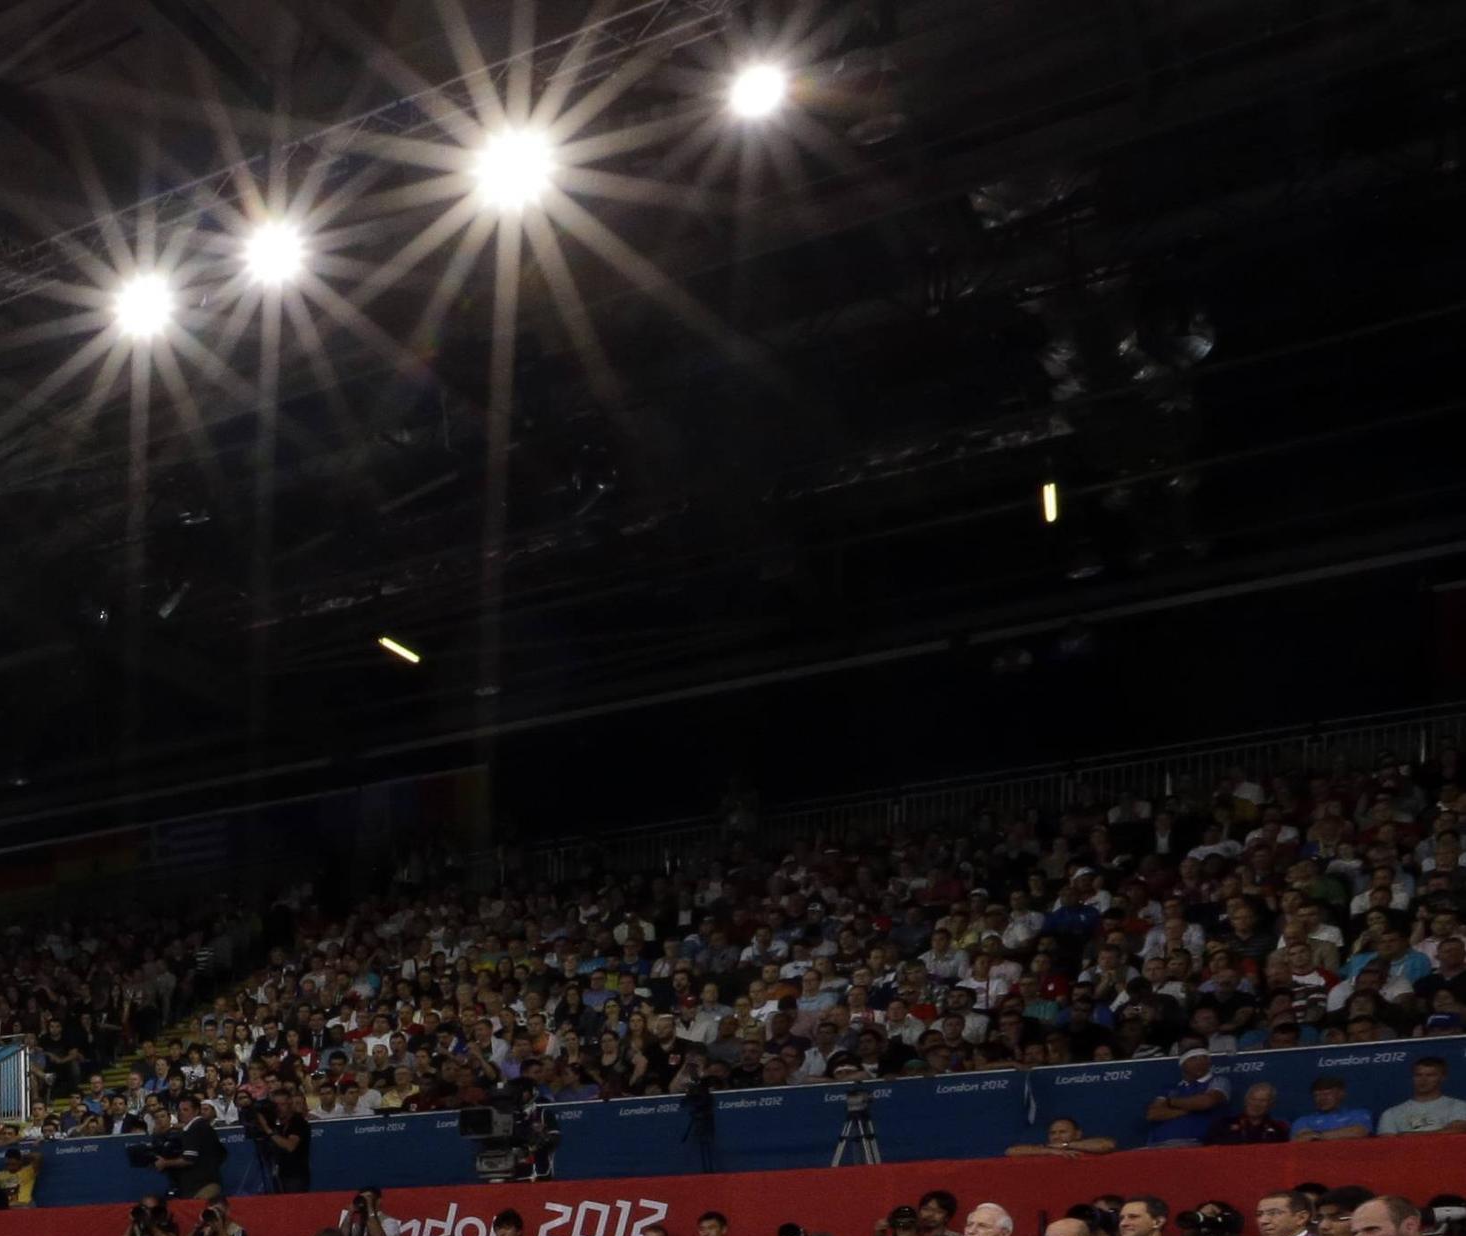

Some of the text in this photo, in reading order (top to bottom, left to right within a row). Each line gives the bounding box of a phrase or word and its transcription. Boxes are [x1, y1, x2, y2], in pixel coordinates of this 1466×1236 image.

[1317, 1051, 1407, 1067] London 2012
[1054, 1070, 1133, 1085] London 2012
[936, 1079, 1009, 1094] London 2012
